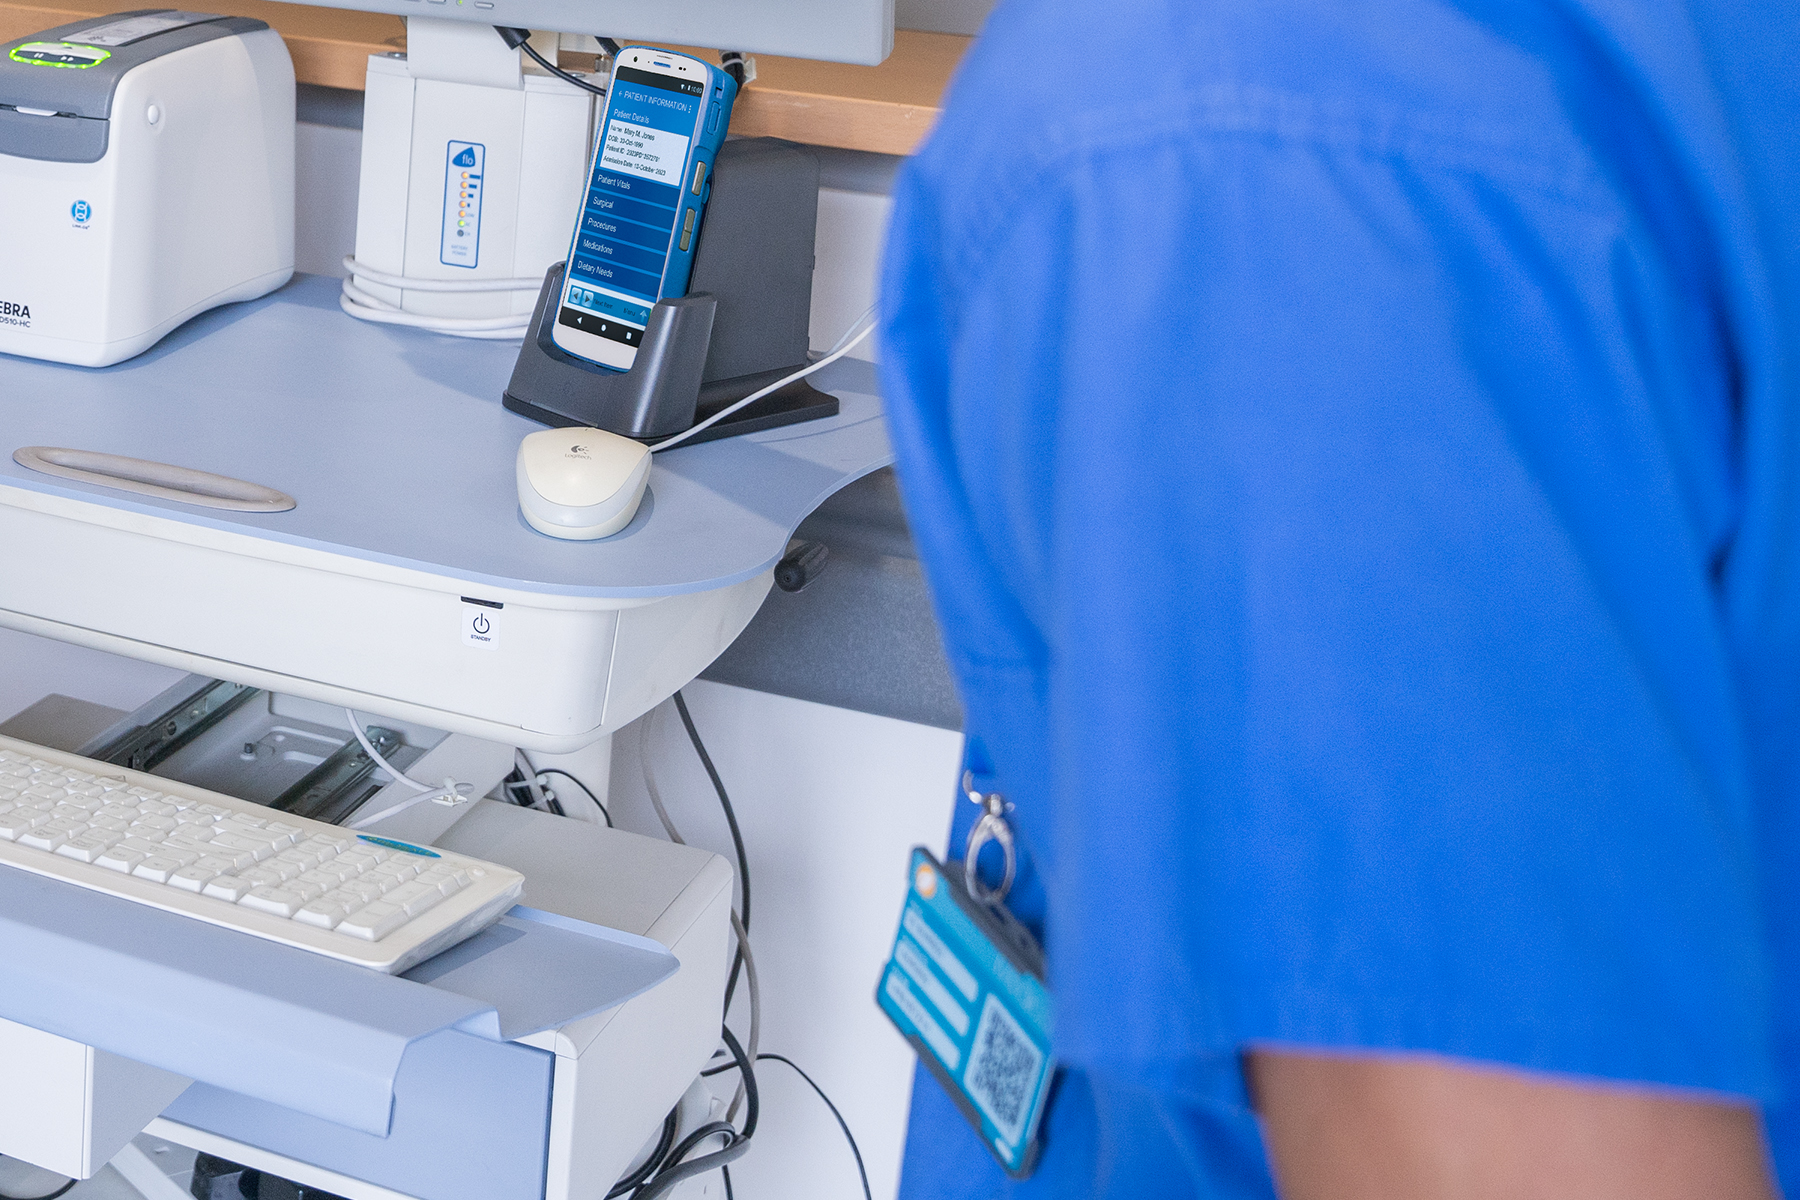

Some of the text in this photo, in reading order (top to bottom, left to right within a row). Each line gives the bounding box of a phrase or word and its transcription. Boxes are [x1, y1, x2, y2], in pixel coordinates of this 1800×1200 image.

[624, 91, 688, 112] PATIENT INFORMATION
[613, 108, 650, 124] Patient Details
[462, 153, 474, 165] flo
[597, 174, 631, 190] Patient Vitals
[592, 196, 614, 209] Surgical
[587, 217, 617, 233] Procedures
[583, 239, 614, 255] Medications
[577, 260, 614, 279] Dietary Needs
[470, 634, 491, 642] STANDBY
